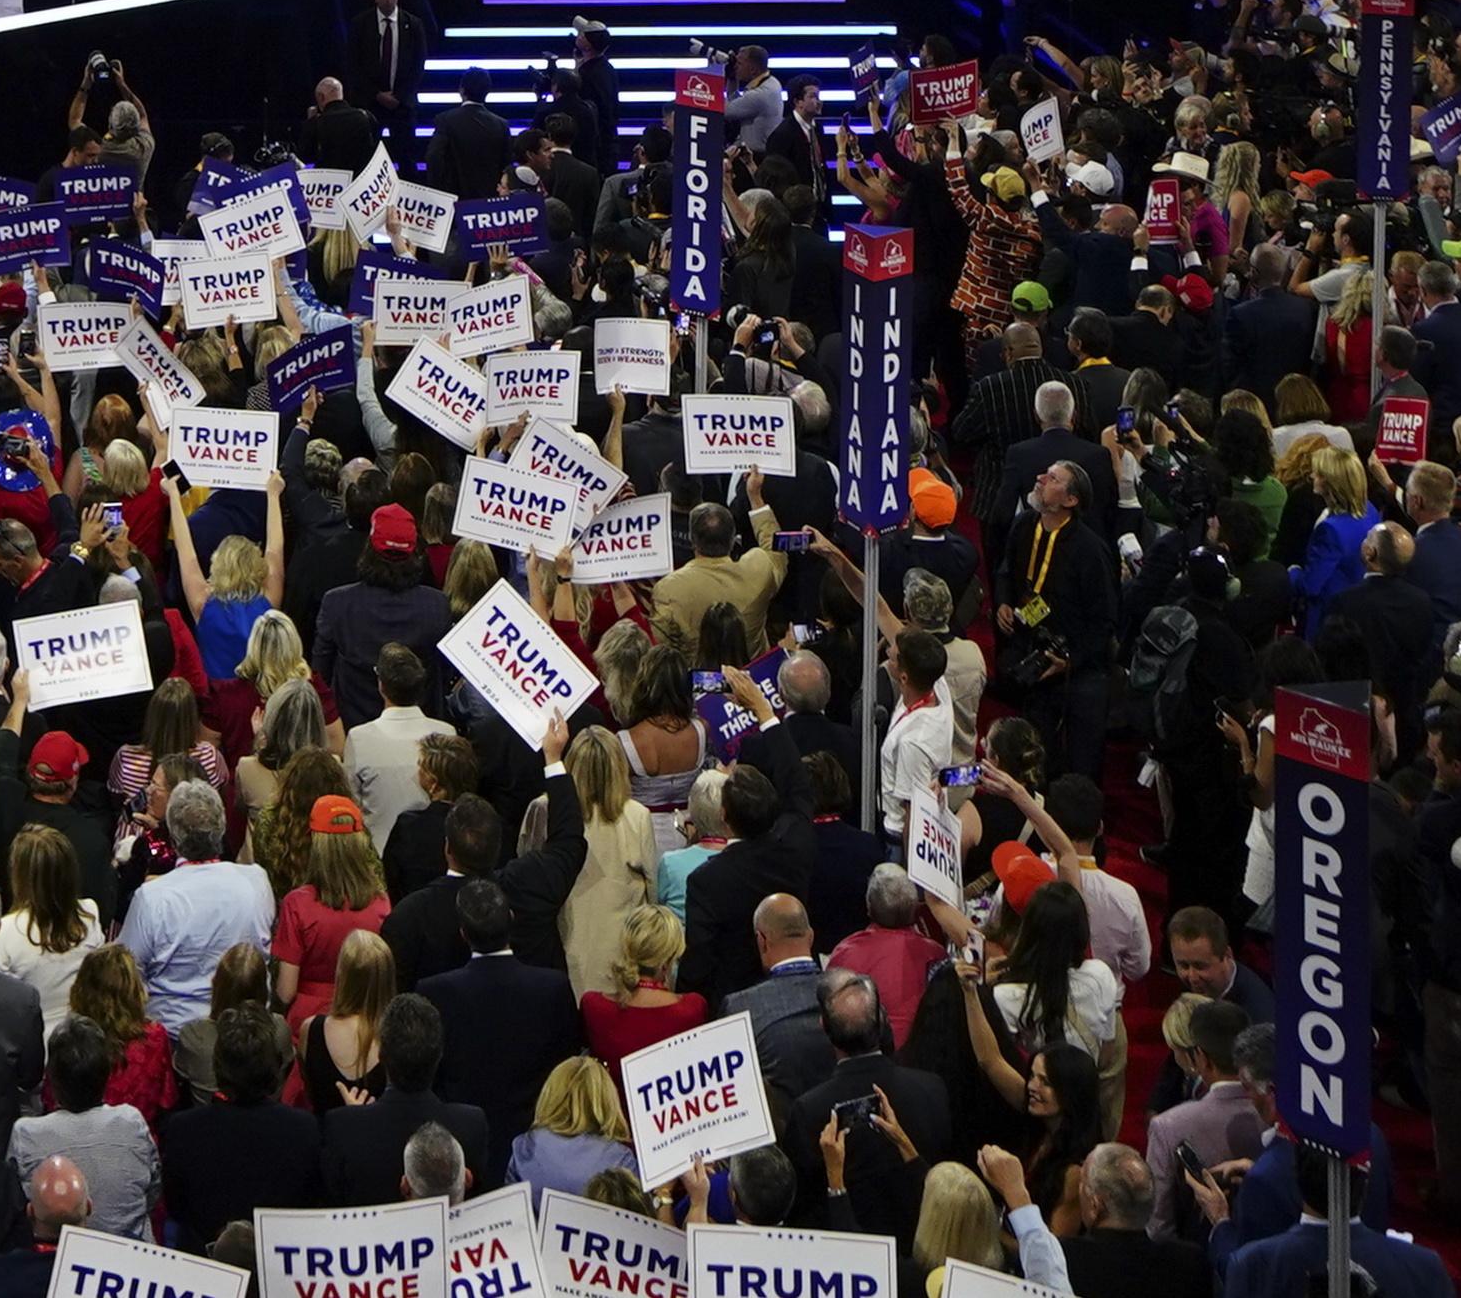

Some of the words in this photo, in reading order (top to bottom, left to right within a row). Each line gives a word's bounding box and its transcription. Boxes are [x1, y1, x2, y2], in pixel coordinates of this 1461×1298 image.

[916, 73, 975, 97] TRUMP
[924, 87, 971, 108] VANCE
[1376, 19, 1394, 191] PENNSYLVANIA
[61, 176, 133, 196] TRUMP
[349, 159, 390, 213] TRUMP
[362, 176, 393, 218] VANCE
[211, 204, 286, 243] TRUMP
[463, 206, 539, 231] TRUMP
[683, 114, 710, 302] FLORIDA
[224, 222, 285, 254] VANCE
[96, 248, 162, 284] TRUMP
[188, 268, 266, 294] TRUMP
[199, 284, 260, 306] VANCE
[382, 296, 448, 314] TRUM
[450, 293, 523, 324] TRUMP
[47, 316, 127, 335] TRUMP
[457, 310, 516, 336] VANCE
[57, 331, 120, 348] VANCE
[135, 345, 181, 404] VANCE
[136, 329, 193, 402] TRUMP
[273, 341, 346, 386] TRUMP
[493, 367, 571, 389] TRUMP
[415, 376, 477, 425] VANCE
[499, 384, 561, 402] VANCE
[847, 284, 864, 513] INDIANA
[880, 287, 902, 515] INDIANA
[693, 413, 785, 433] TRUMP
[1383, 412, 1423, 430] TRUMP
[179, 426, 269, 449] TRUMP
[704, 433, 777, 449] VANCE
[1382, 429, 1416, 445] VANCE
[187, 445, 259, 465] VANCE
[531, 433, 608, 494] TRUMP
[473, 477, 566, 515] TRUMP
[479, 498, 554, 531] VANCE
[500, 537, 520, 548] 2024
[581, 534, 653, 556] VANCE
[28, 625, 133, 661] TRUMP
[485, 605, 573, 700] TRUMP
[42, 649, 124, 678] VANCE
[480, 630, 551, 709] VANCE
[481, 682, 501, 704] 2024
[1290, 731, 1352, 759] MILWAUKEE
[1297, 782, 1347, 1128] OREGON
[636, 1049, 746, 1113] TRUMP
[652, 1083, 740, 1135] VANCE
[652, 1141, 669, 1153] MAKE
[669, 1127, 698, 1146] AMERICA
[697, 1119, 722, 1133] GREAT
[722, 1110, 750, 1124] AGAIN!
[274, 1235, 435, 1279] TRUMP
[555, 1223, 689, 1283] TRUM
[294, 1274, 420, 1298] VANCE
[555, 1284, 582, 1296] MAKE
[707, 1262, 881, 1298] TRUMP
